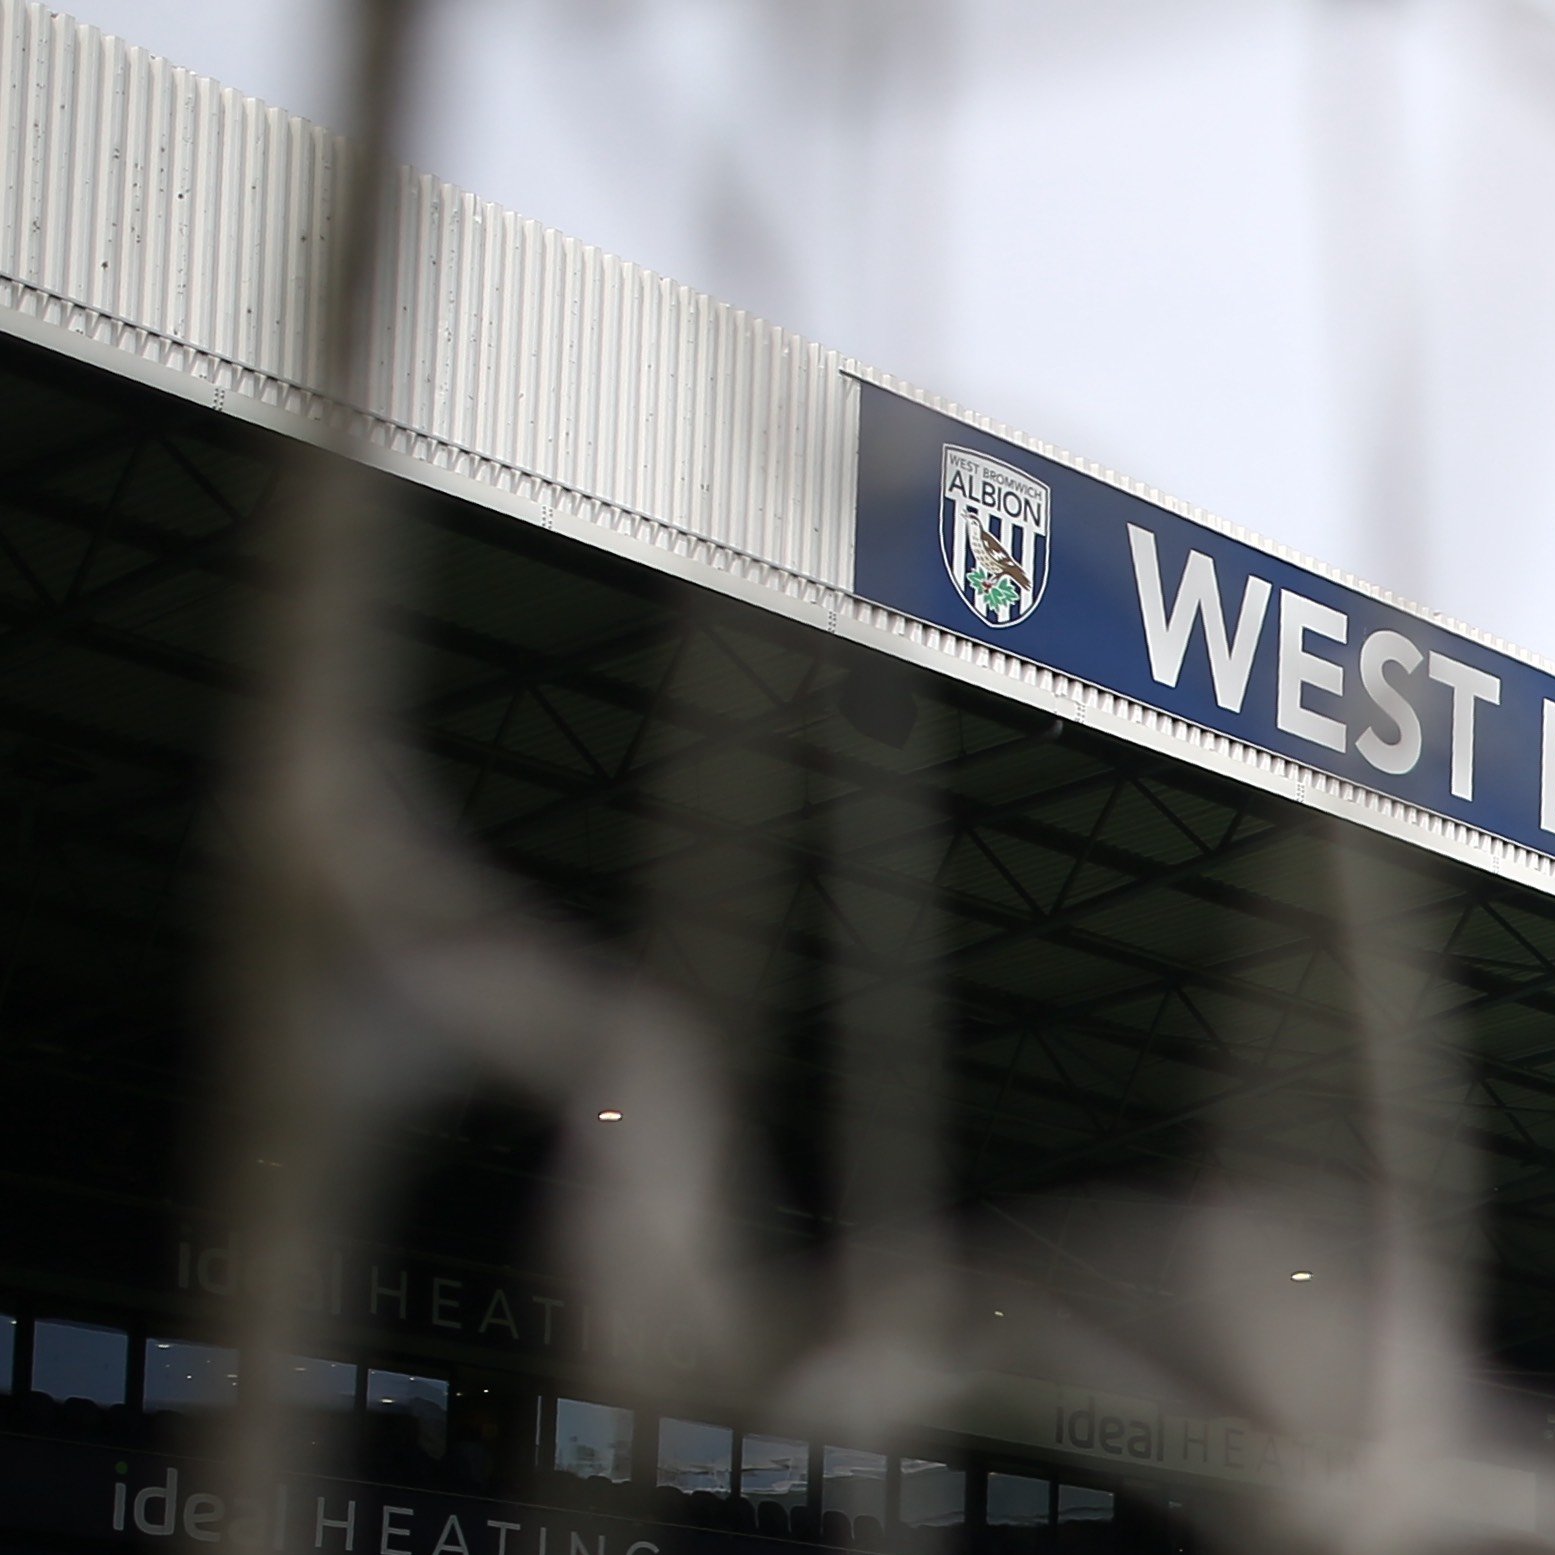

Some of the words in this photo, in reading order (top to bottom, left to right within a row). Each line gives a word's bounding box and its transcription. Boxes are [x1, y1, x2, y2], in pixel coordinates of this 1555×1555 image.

[949, 470, 1041, 527] ALBION
[950, 455, 979, 474] WEST
[983, 467, 1042, 501] BROMWICH
[1127, 522, 1501, 801] WEST
